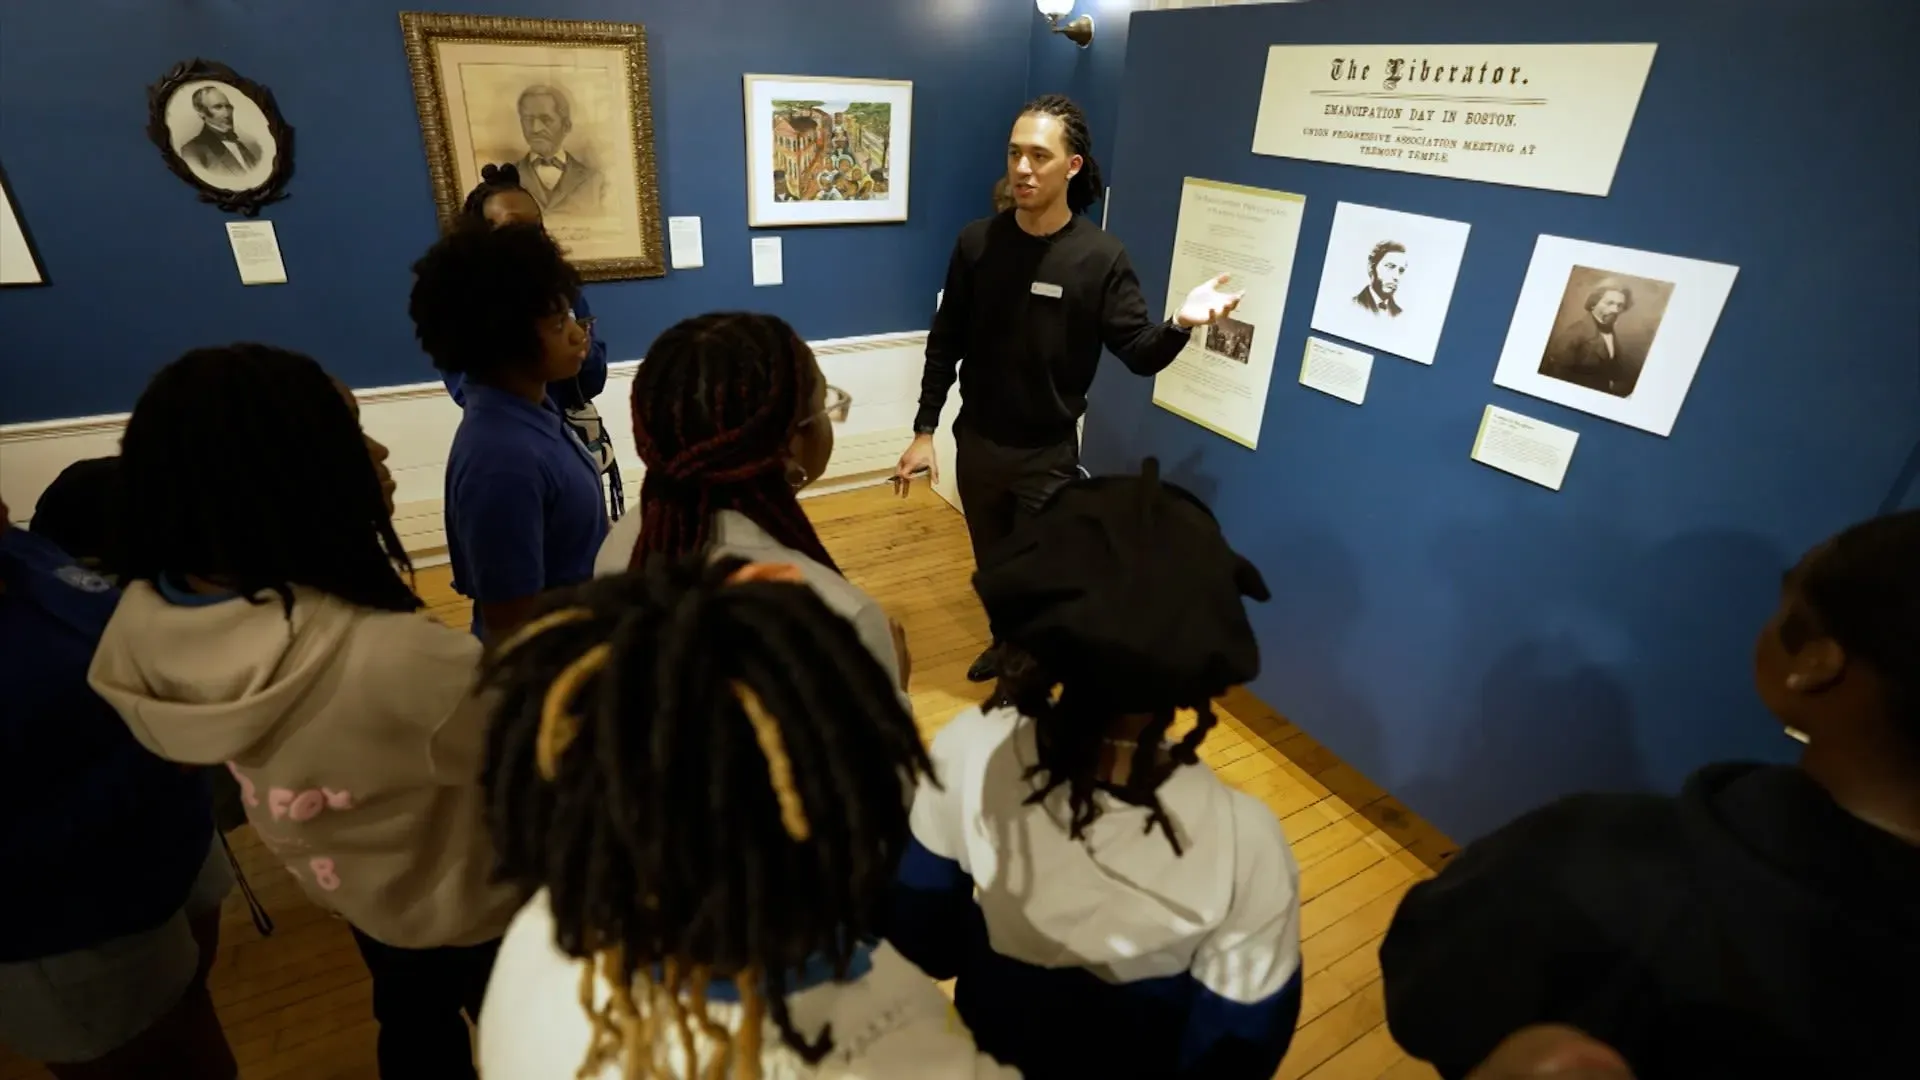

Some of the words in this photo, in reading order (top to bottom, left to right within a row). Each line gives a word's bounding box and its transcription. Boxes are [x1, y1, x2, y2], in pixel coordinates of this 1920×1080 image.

[1330, 58, 1371, 81] The
[1382, 57, 1529, 90] Liberator.
[1323, 104, 1404, 119] EMANCIPATION
[1408, 108, 1436, 121] DAY
[1441, 109, 1458, 123] IN
[1464, 111, 1518, 127] BOSTON.
[1302, 128, 1330, 138] UNION
[1331, 129, 1392, 143] PROGRESSIVE
[1395, 135, 1458, 149] ASSOCIATION
[1462, 140, 1515, 153] MEETING
[1519, 144, 1537, 155] AT
[1360, 146, 1404, 158] TREMONT
